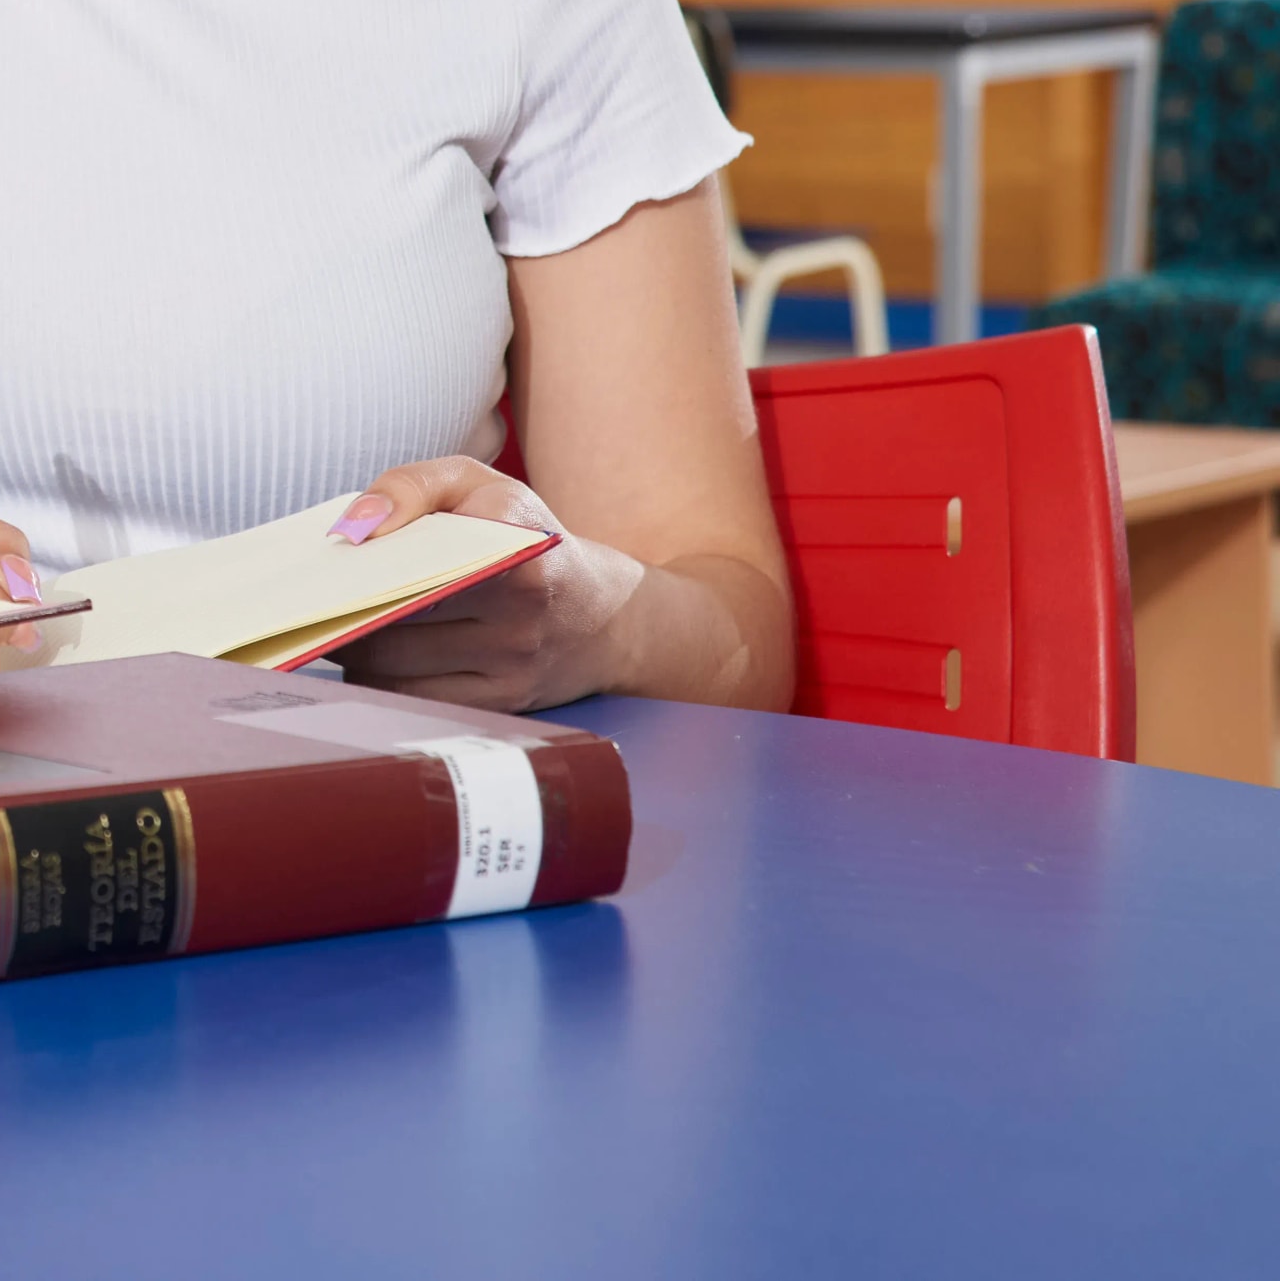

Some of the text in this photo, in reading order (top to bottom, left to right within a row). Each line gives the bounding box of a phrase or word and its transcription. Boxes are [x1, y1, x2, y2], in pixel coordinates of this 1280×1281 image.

[83, 813, 115, 952] TEORÍA
[116, 847, 139, 913] DEL
[136, 807, 166, 946] ESTADO
[475, 826, 491, 878] 320.1
[497, 838, 511, 873] SER
[41, 851, 67, 928] ROJAS
